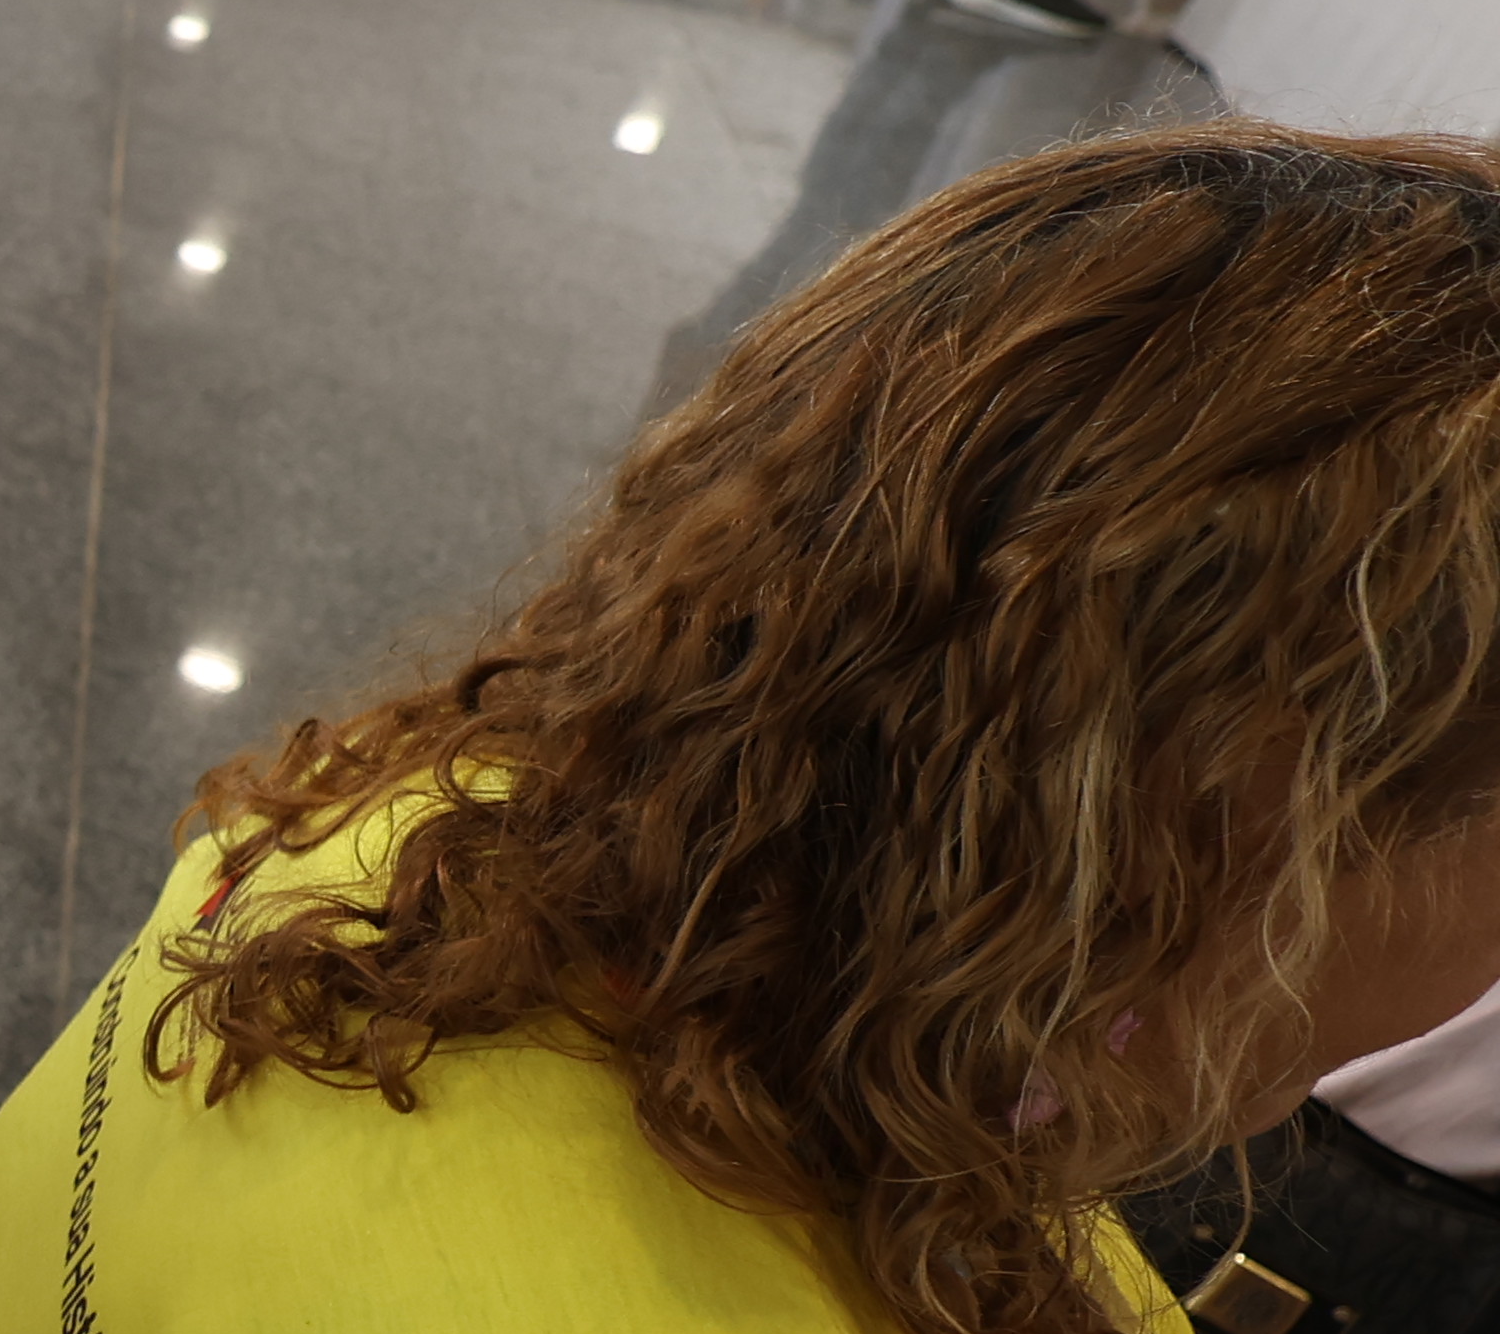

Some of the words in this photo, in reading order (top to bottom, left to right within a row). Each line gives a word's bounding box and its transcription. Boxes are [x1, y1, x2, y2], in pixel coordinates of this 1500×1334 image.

[78, 947, 140, 1156] Construindo
[74, 1149, 100, 1192] a
[65, 1180, 97, 1267] sua
